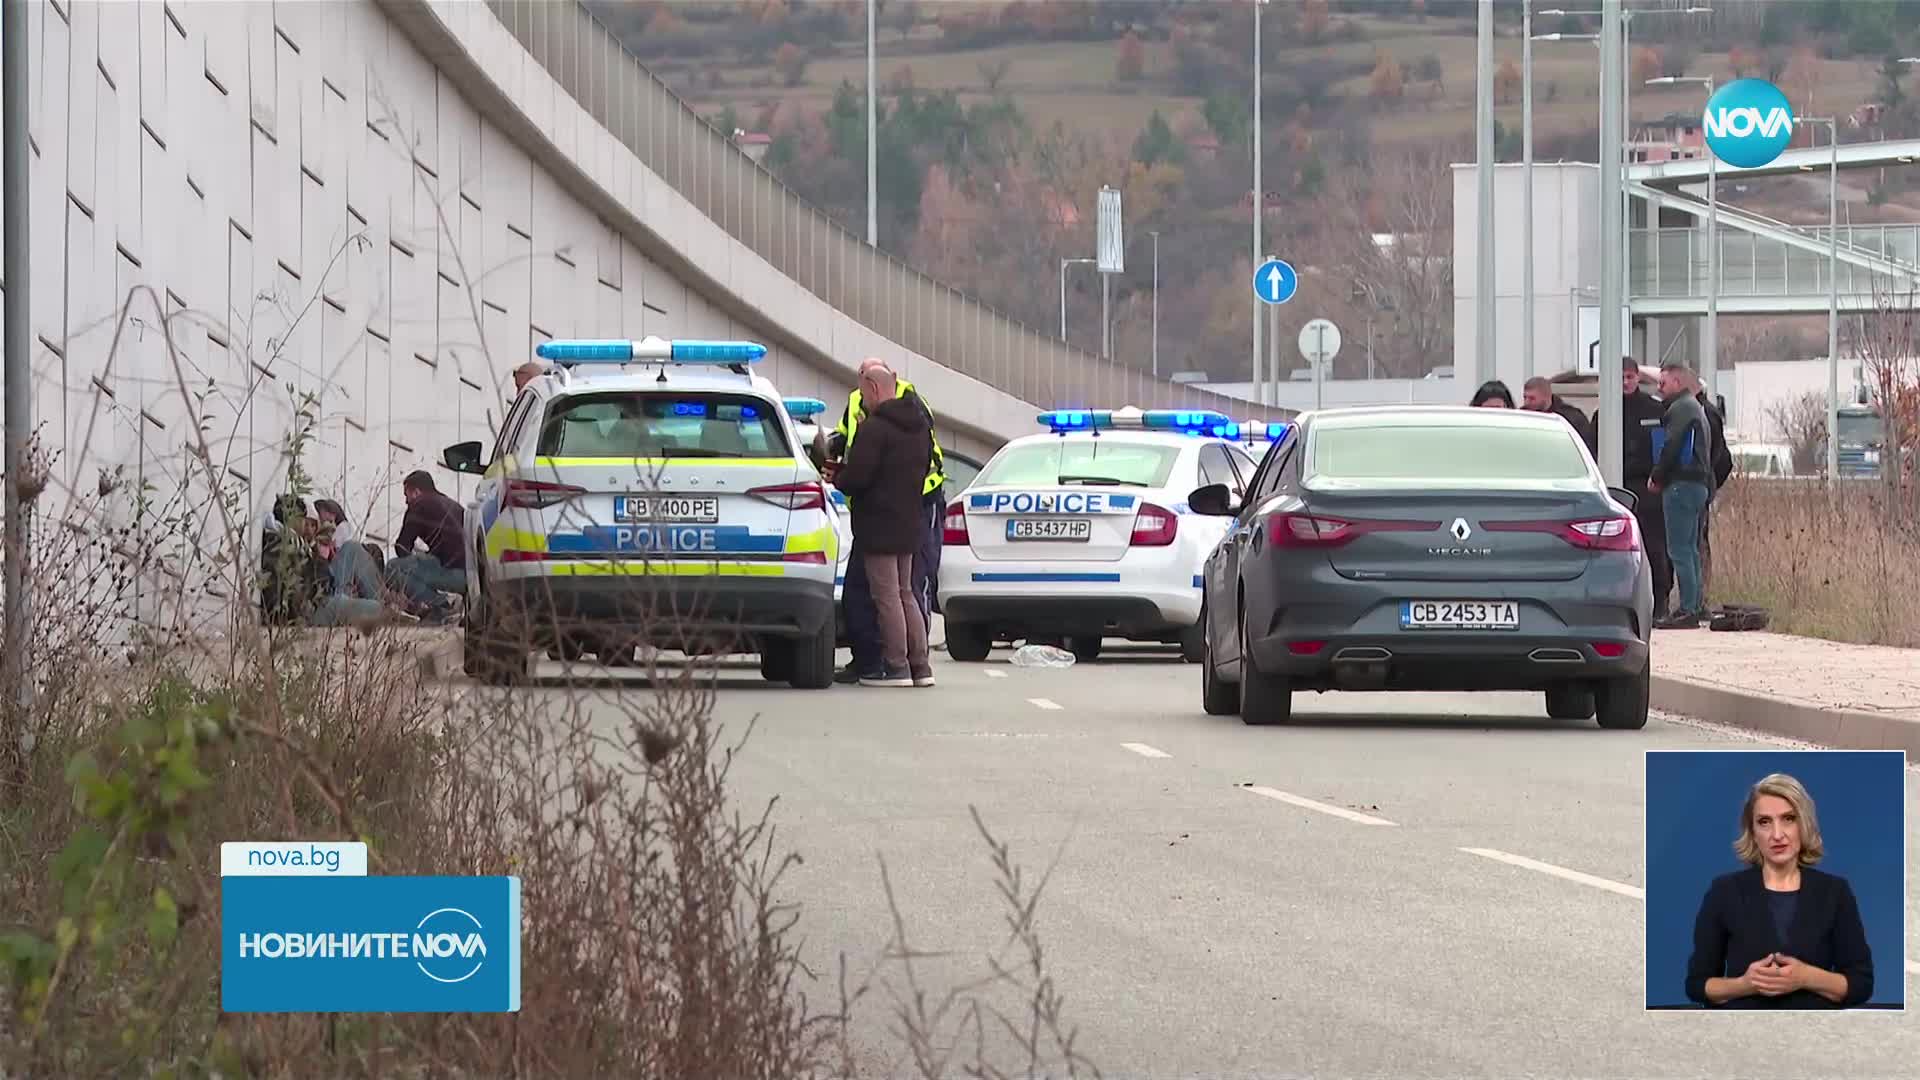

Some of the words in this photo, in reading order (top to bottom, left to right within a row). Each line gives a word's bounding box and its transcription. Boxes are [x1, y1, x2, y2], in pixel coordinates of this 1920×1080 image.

[994, 493, 1103, 513] POLICE
[616, 528, 716, 550] POLICE
[1441, 604, 1487, 622] 2453
[1491, 604, 1515, 622] TA
